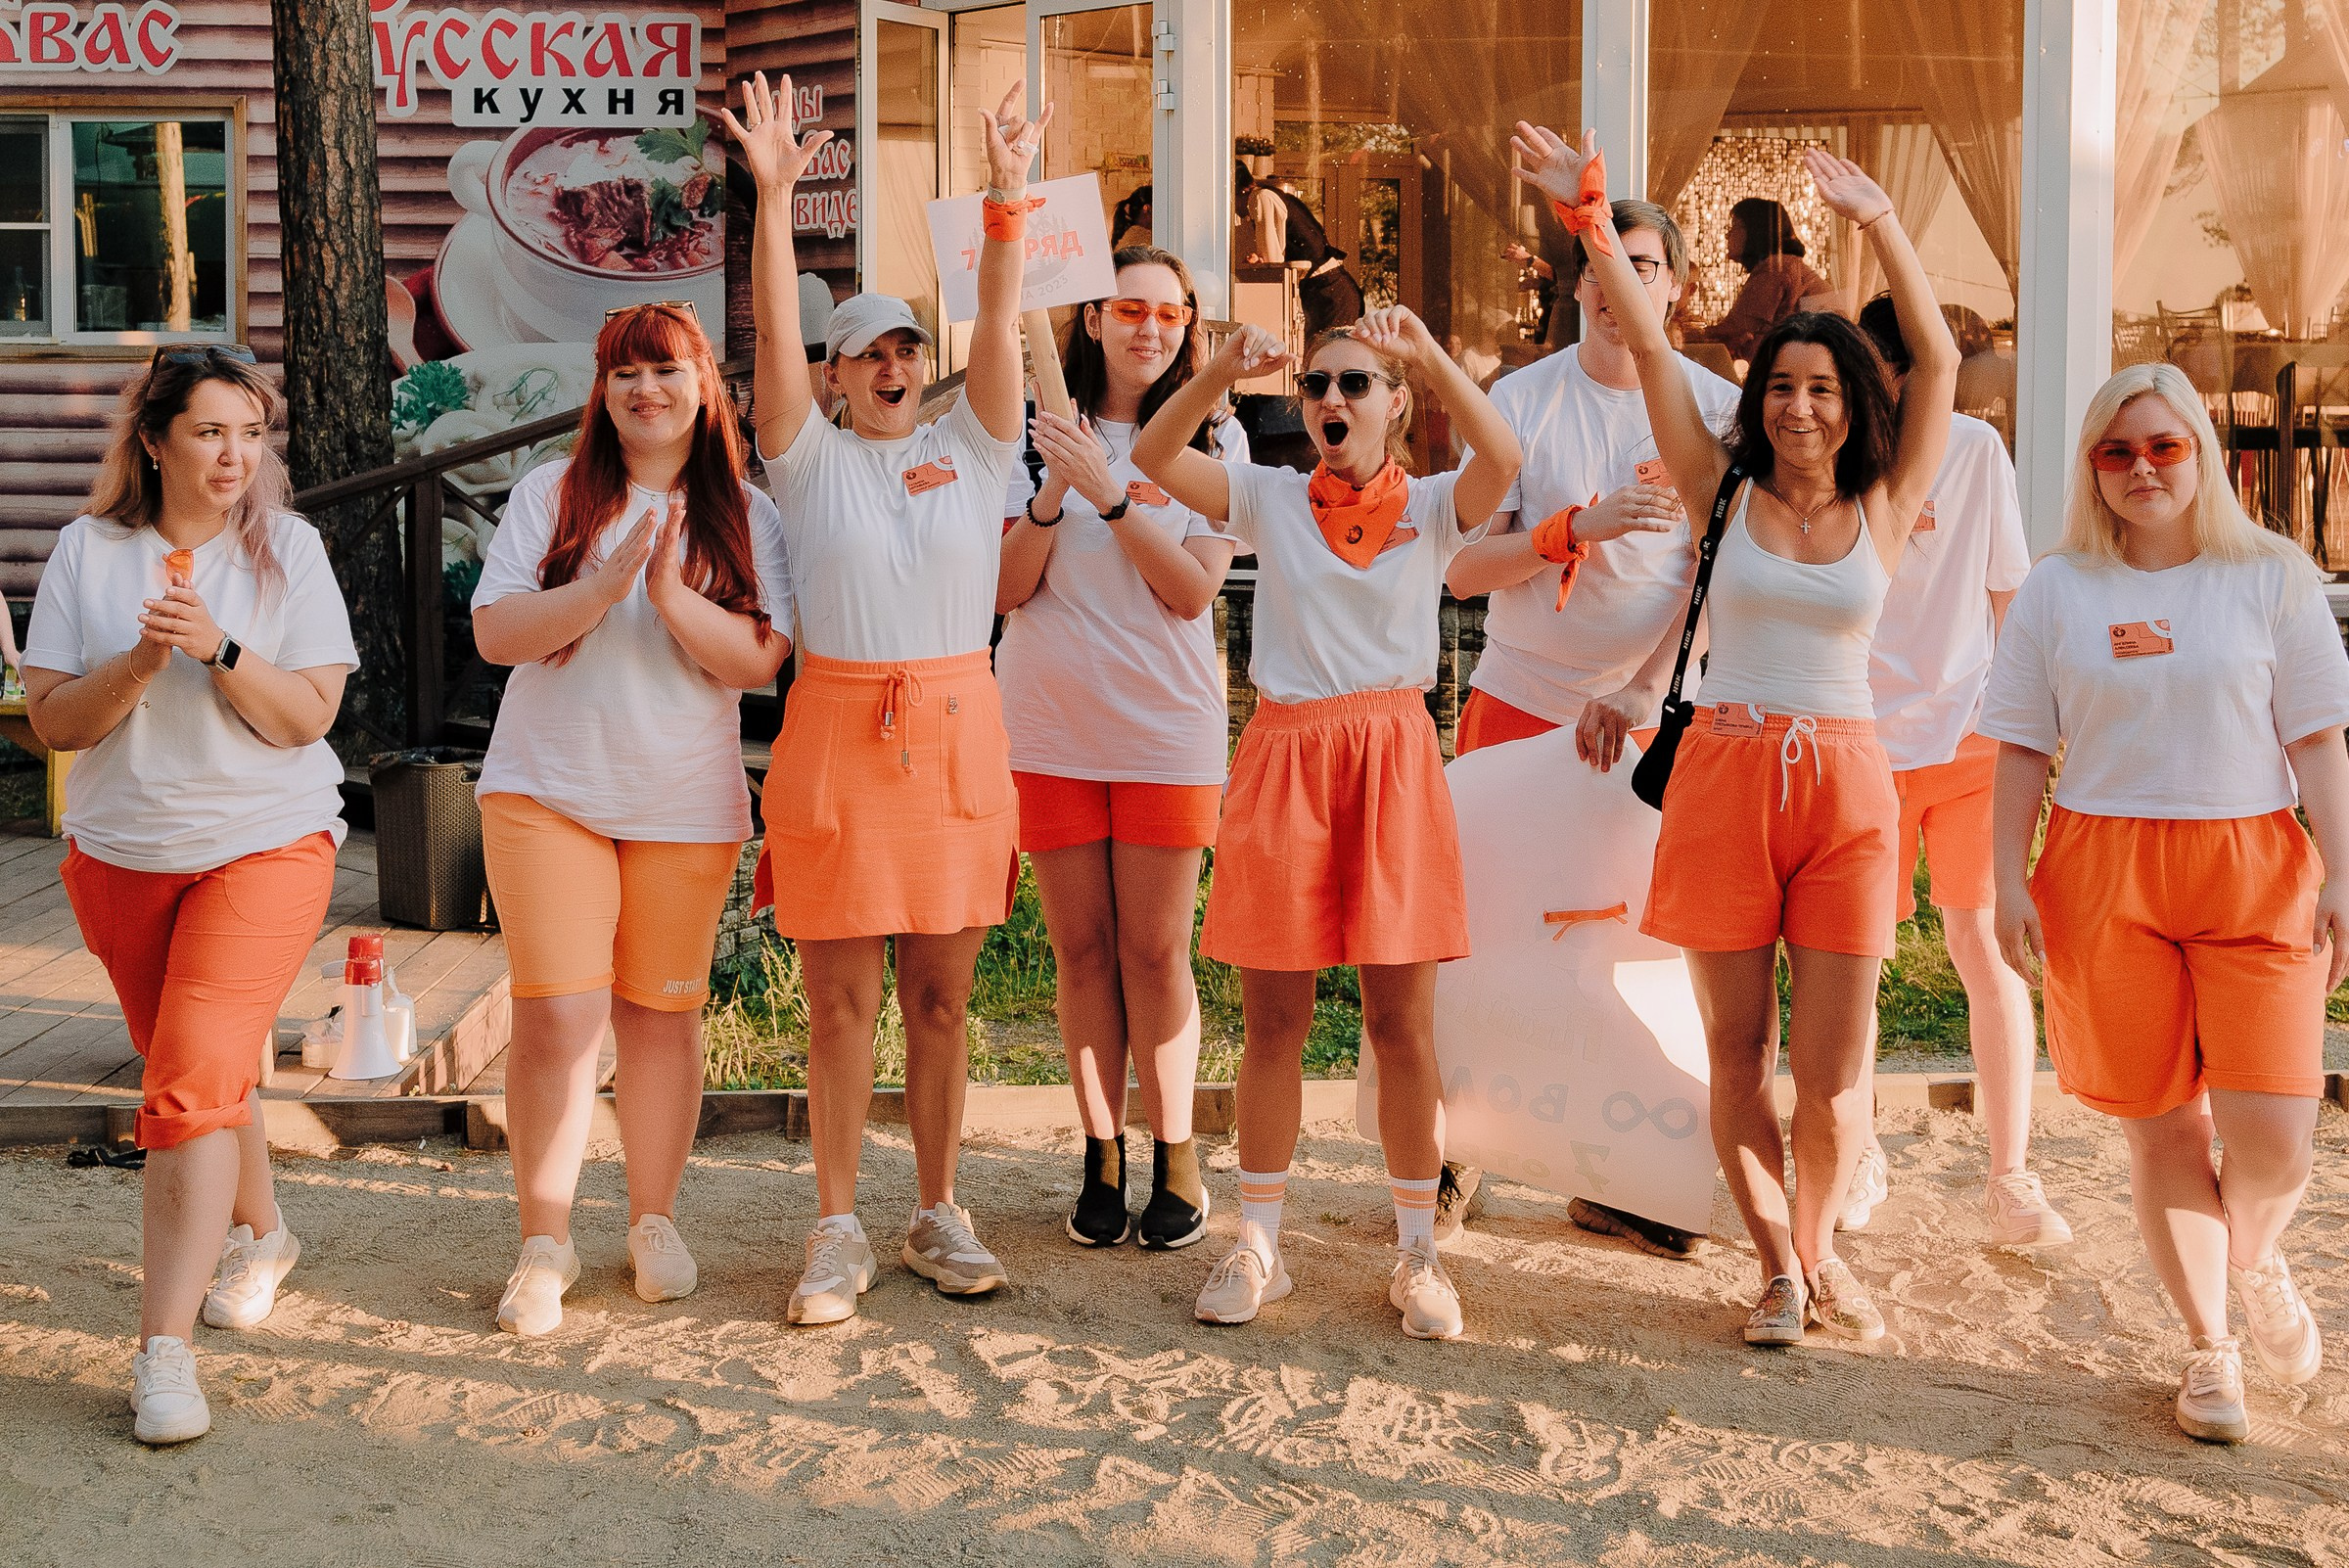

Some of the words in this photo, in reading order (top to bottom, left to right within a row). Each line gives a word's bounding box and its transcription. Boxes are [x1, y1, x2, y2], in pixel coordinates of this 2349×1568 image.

[0, 0, 174, 68] вас
[369, 0, 693, 108] усская
[473, 87, 685, 123] кухня
[1024, 230, 1084, 260] РЯД
[663, 979, 685, 994] JUST
